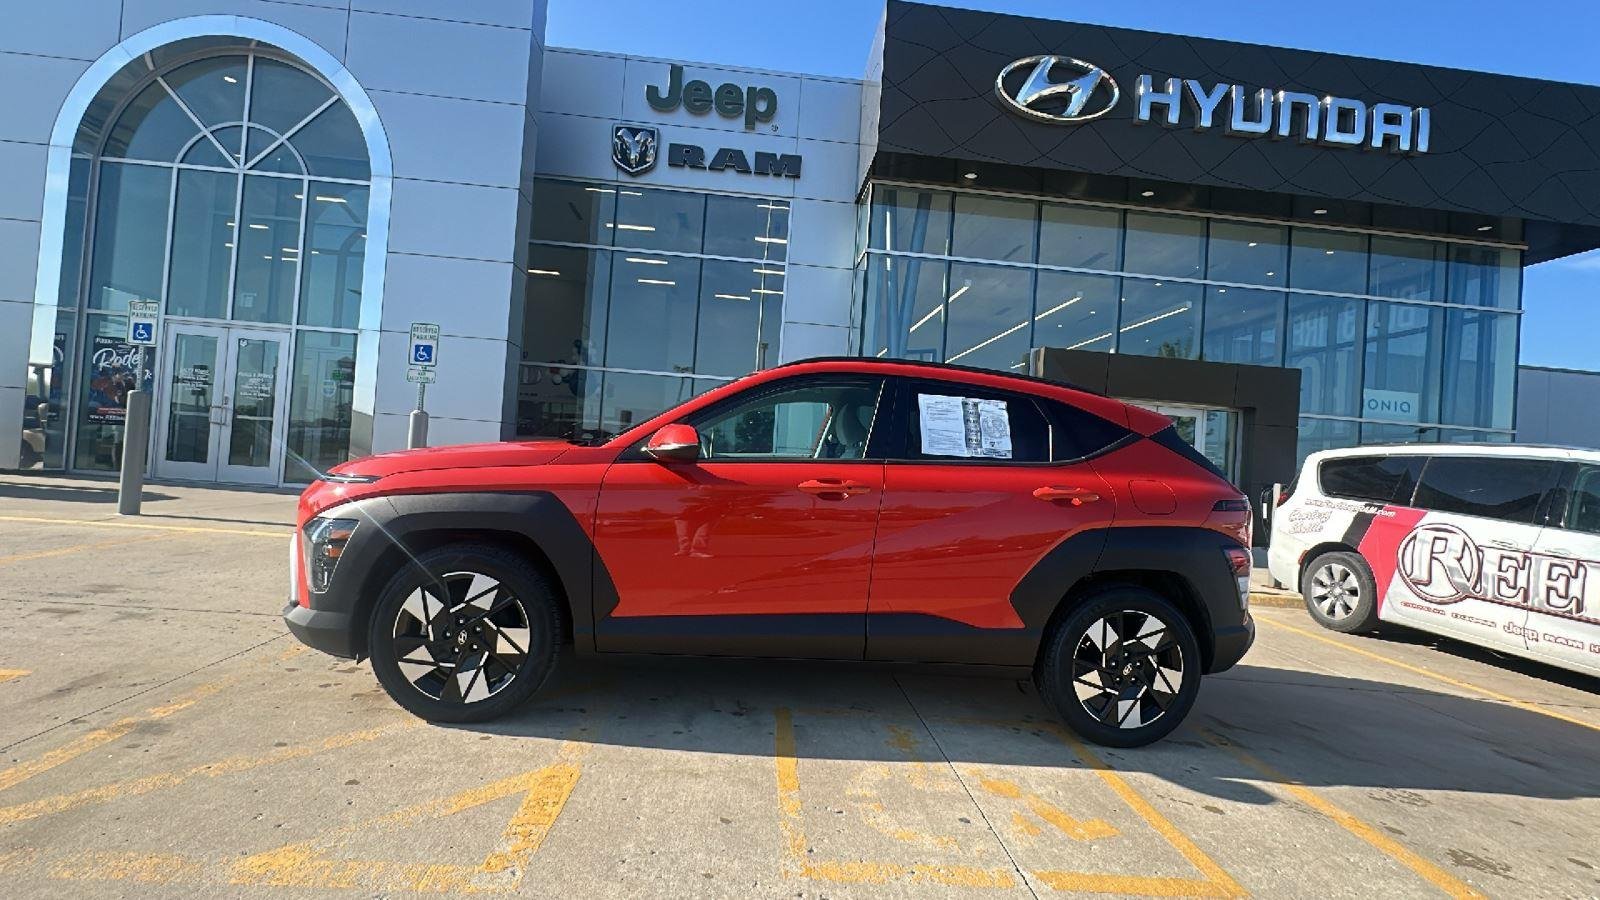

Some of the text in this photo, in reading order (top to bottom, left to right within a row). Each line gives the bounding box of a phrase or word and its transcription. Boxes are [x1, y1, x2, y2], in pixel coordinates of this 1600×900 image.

[646, 63, 779, 131] Jeep
[1134, 73, 1432, 155] HYUNDAI
[667, 142, 803, 179] RAM
[92, 346, 149, 371] Rode
[1397, 523, 1600, 622] REE
[1503, 621, 1539, 643] Jeep
